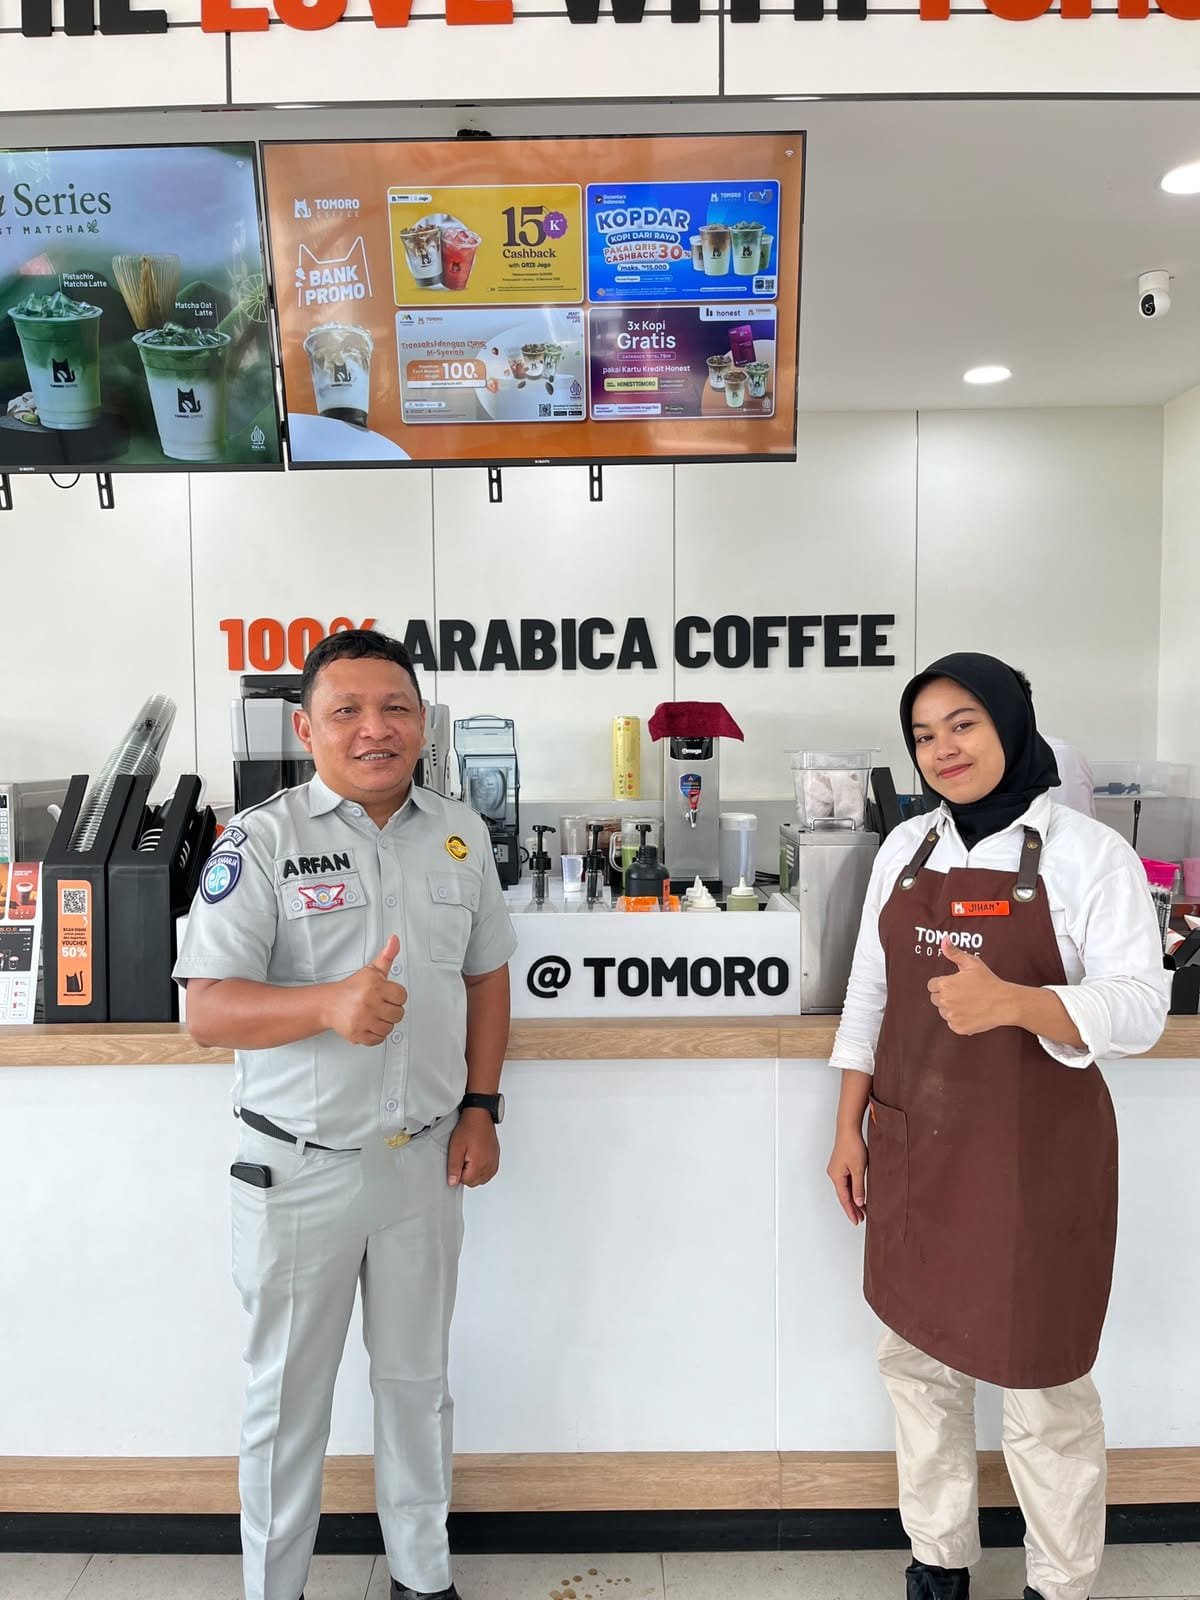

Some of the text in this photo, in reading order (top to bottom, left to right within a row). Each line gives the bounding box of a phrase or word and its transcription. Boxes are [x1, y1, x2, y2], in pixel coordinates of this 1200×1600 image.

[13, 183, 111, 216] Series
[314, 199, 360, 210] TOMORO
[502, 206, 547, 247] 15
[597, 209, 688, 231] KOPDAR
[23, 225, 84, 234] MATCHA
[610, 231, 676, 243] KOPI DARI RAYA
[502, 248, 557, 259] Cashback
[604, 243, 656, 256] PAKAI QRIS
[309, 265, 358, 287] BANK
[89, 280, 107, 288] Latte
[305, 283, 366, 306] PROMO
[194, 309, 213, 317] Latte
[716, 309, 741, 317] honest
[627, 320, 666, 332] 3x Kopi
[617, 332, 676, 350] Gratis
[602, 366, 620, 375] pakai
[642, 365, 664, 373] Kredit
[665, 365, 691, 373] Honest
[402, 617, 658, 672] ARABICA
[674, 614, 896, 669] COFFEE
[283, 852, 351, 879] ARFAN
[526, 955, 790, 999] @ TOMORO
